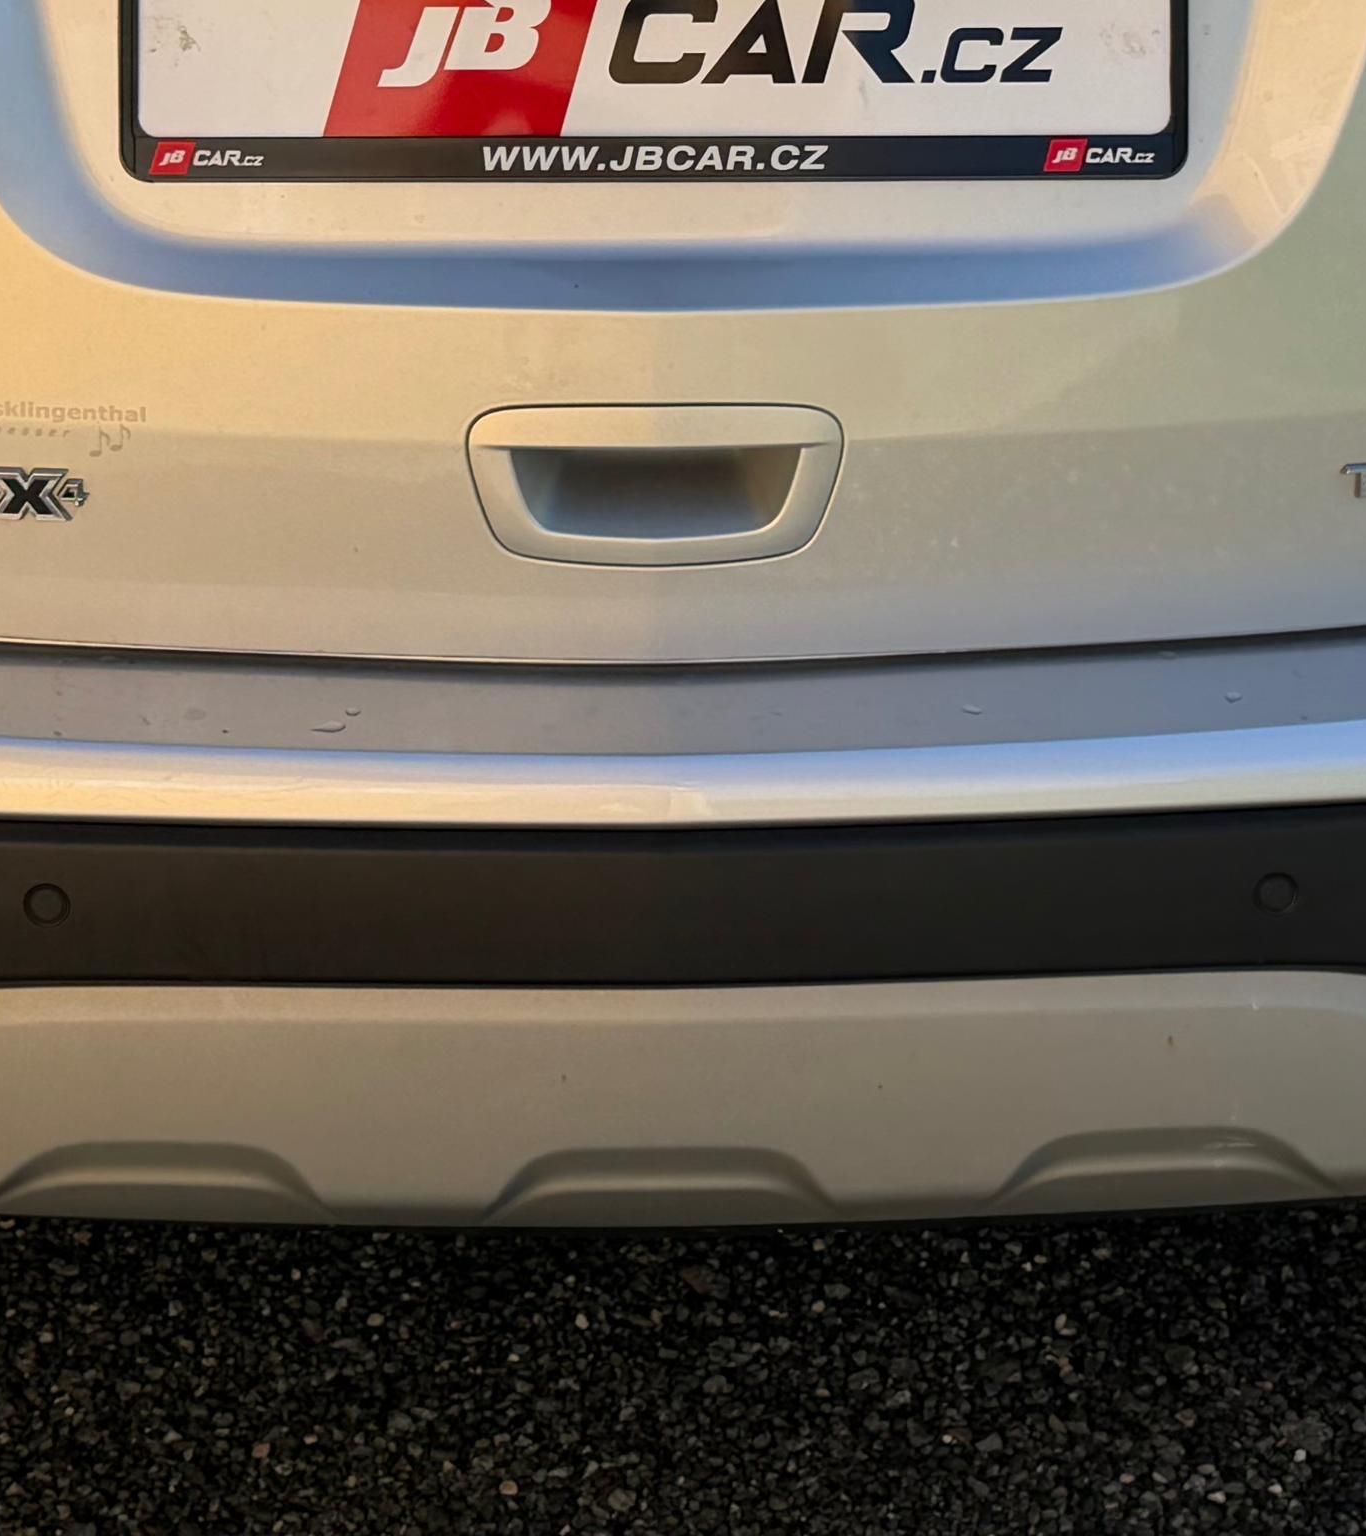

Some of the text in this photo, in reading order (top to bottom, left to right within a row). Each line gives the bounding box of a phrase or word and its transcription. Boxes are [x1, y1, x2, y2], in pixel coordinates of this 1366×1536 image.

[158, 150, 186, 166] JB
[481, 144, 830, 172] WWW.JBCAR.CZ
[1051, 147, 1078, 164] JB
